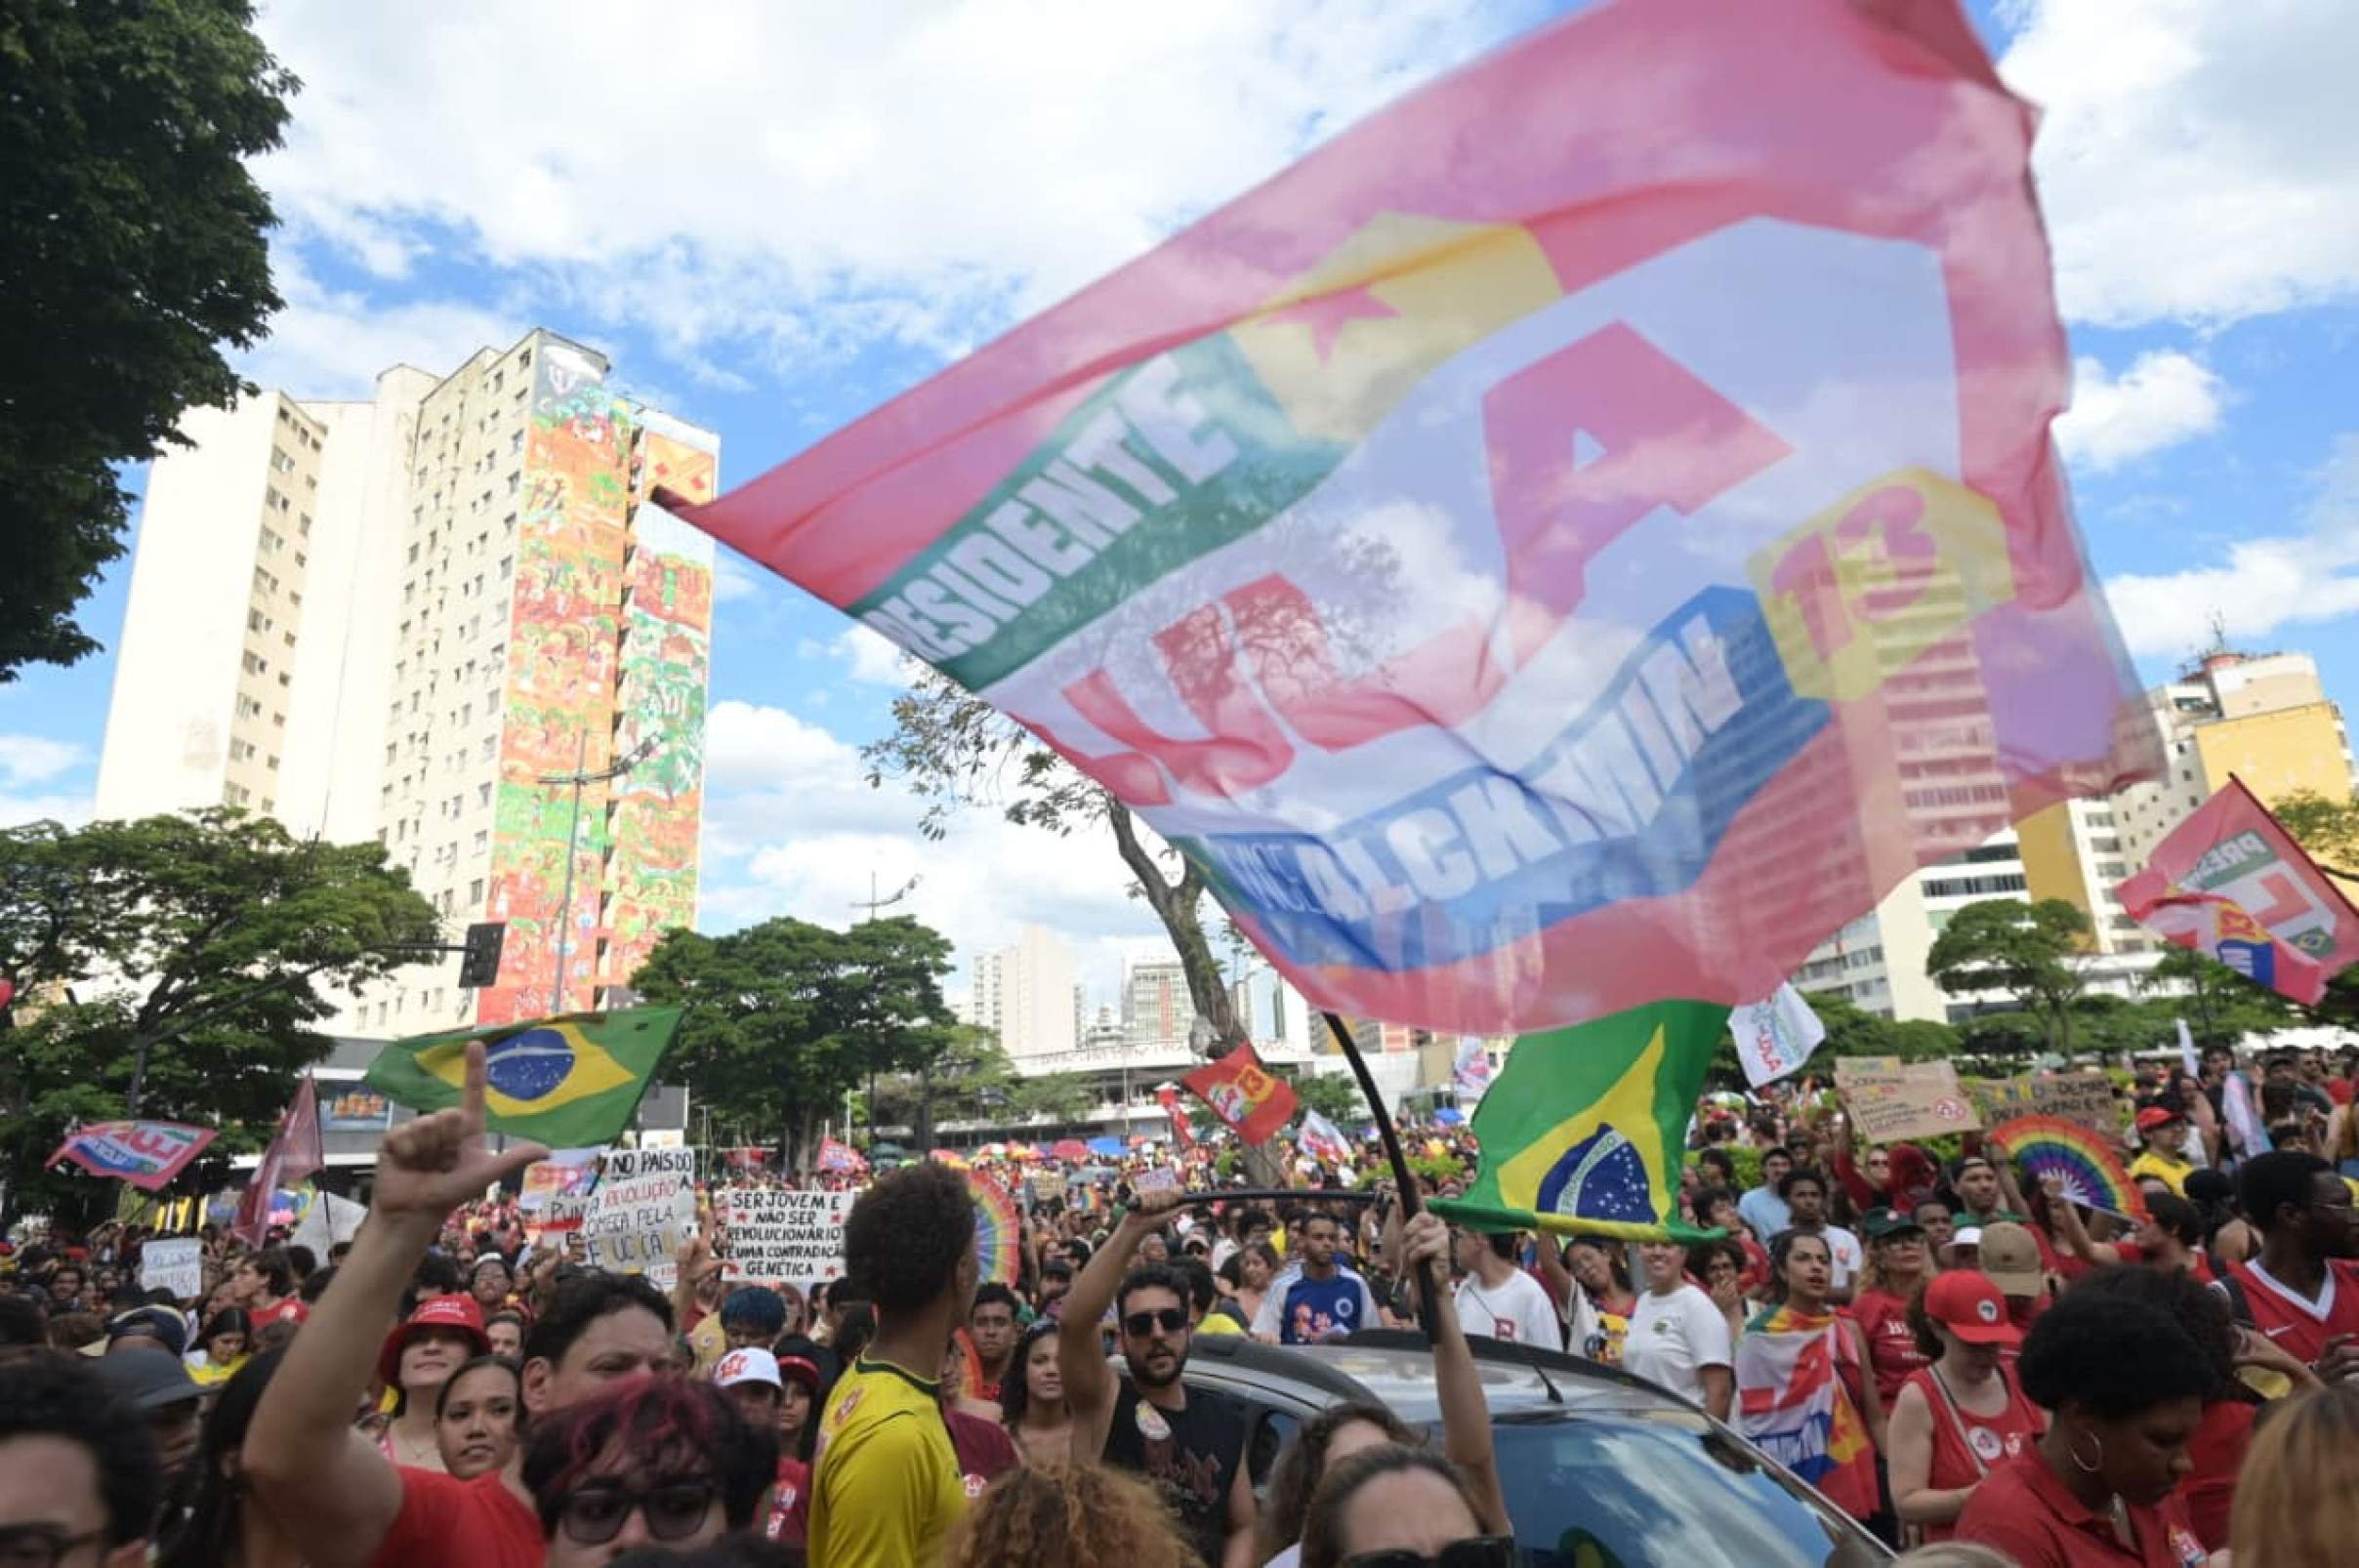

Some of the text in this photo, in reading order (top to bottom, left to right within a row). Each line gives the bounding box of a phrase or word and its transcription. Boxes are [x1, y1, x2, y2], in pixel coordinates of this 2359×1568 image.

[1769, 485, 1937, 665] 13
[1295, 611, 1745, 923] ALCKMIN
[611, 1154, 635, 1173] NO
[732, 1192, 765, 1210] SER
[766, 1191, 825, 1210] JOVEM
[755, 1209, 817, 1226] NÃO SER
[735, 1244, 764, 1259] UMA
[766, 1243, 843, 1259] CONTRADIÇÃ
